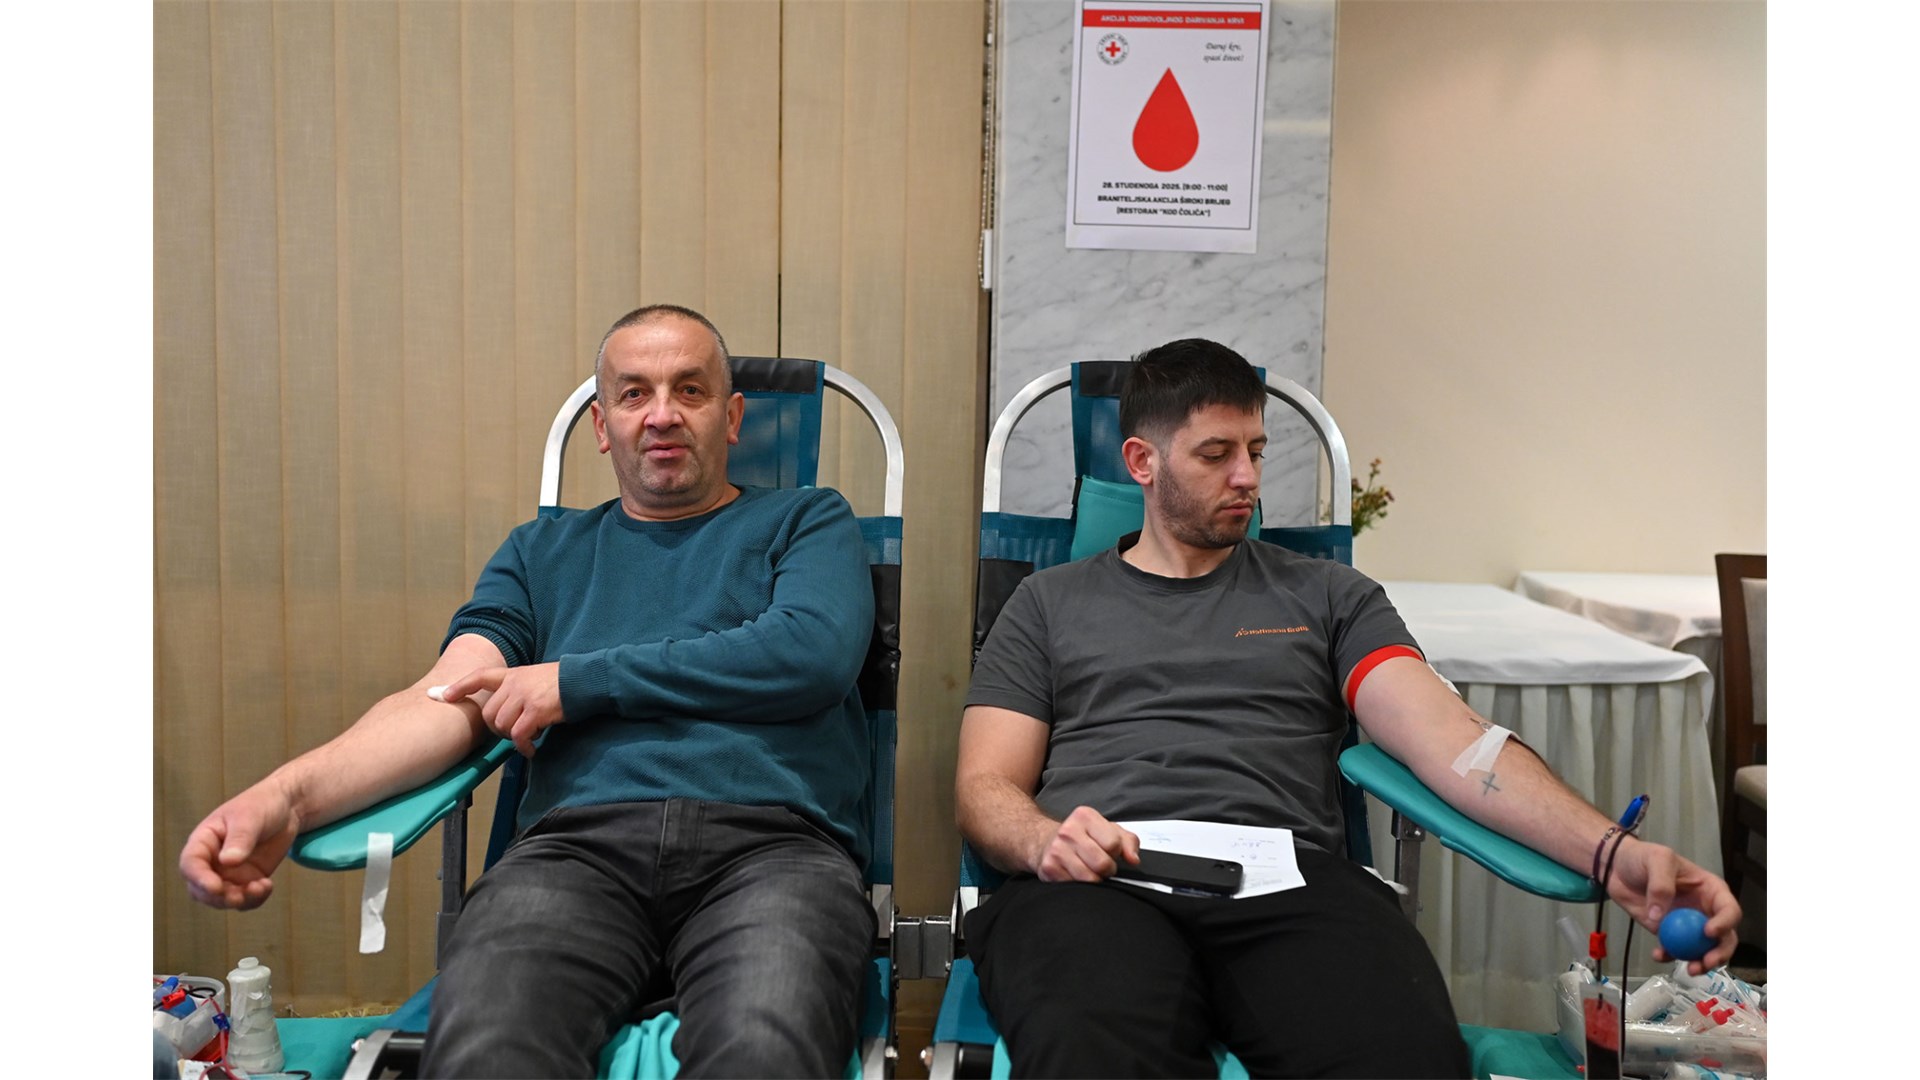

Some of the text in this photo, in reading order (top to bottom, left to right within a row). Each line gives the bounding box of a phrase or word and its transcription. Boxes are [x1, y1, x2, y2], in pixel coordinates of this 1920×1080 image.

[1128, 15, 1184, 23] DOBROVOLJNOG
[1185, 16, 1225, 24] DARIVANJA
[1098, 195, 1152, 203] BRANITELJSKA
[1180, 196, 1204, 204] ŠIROKI
